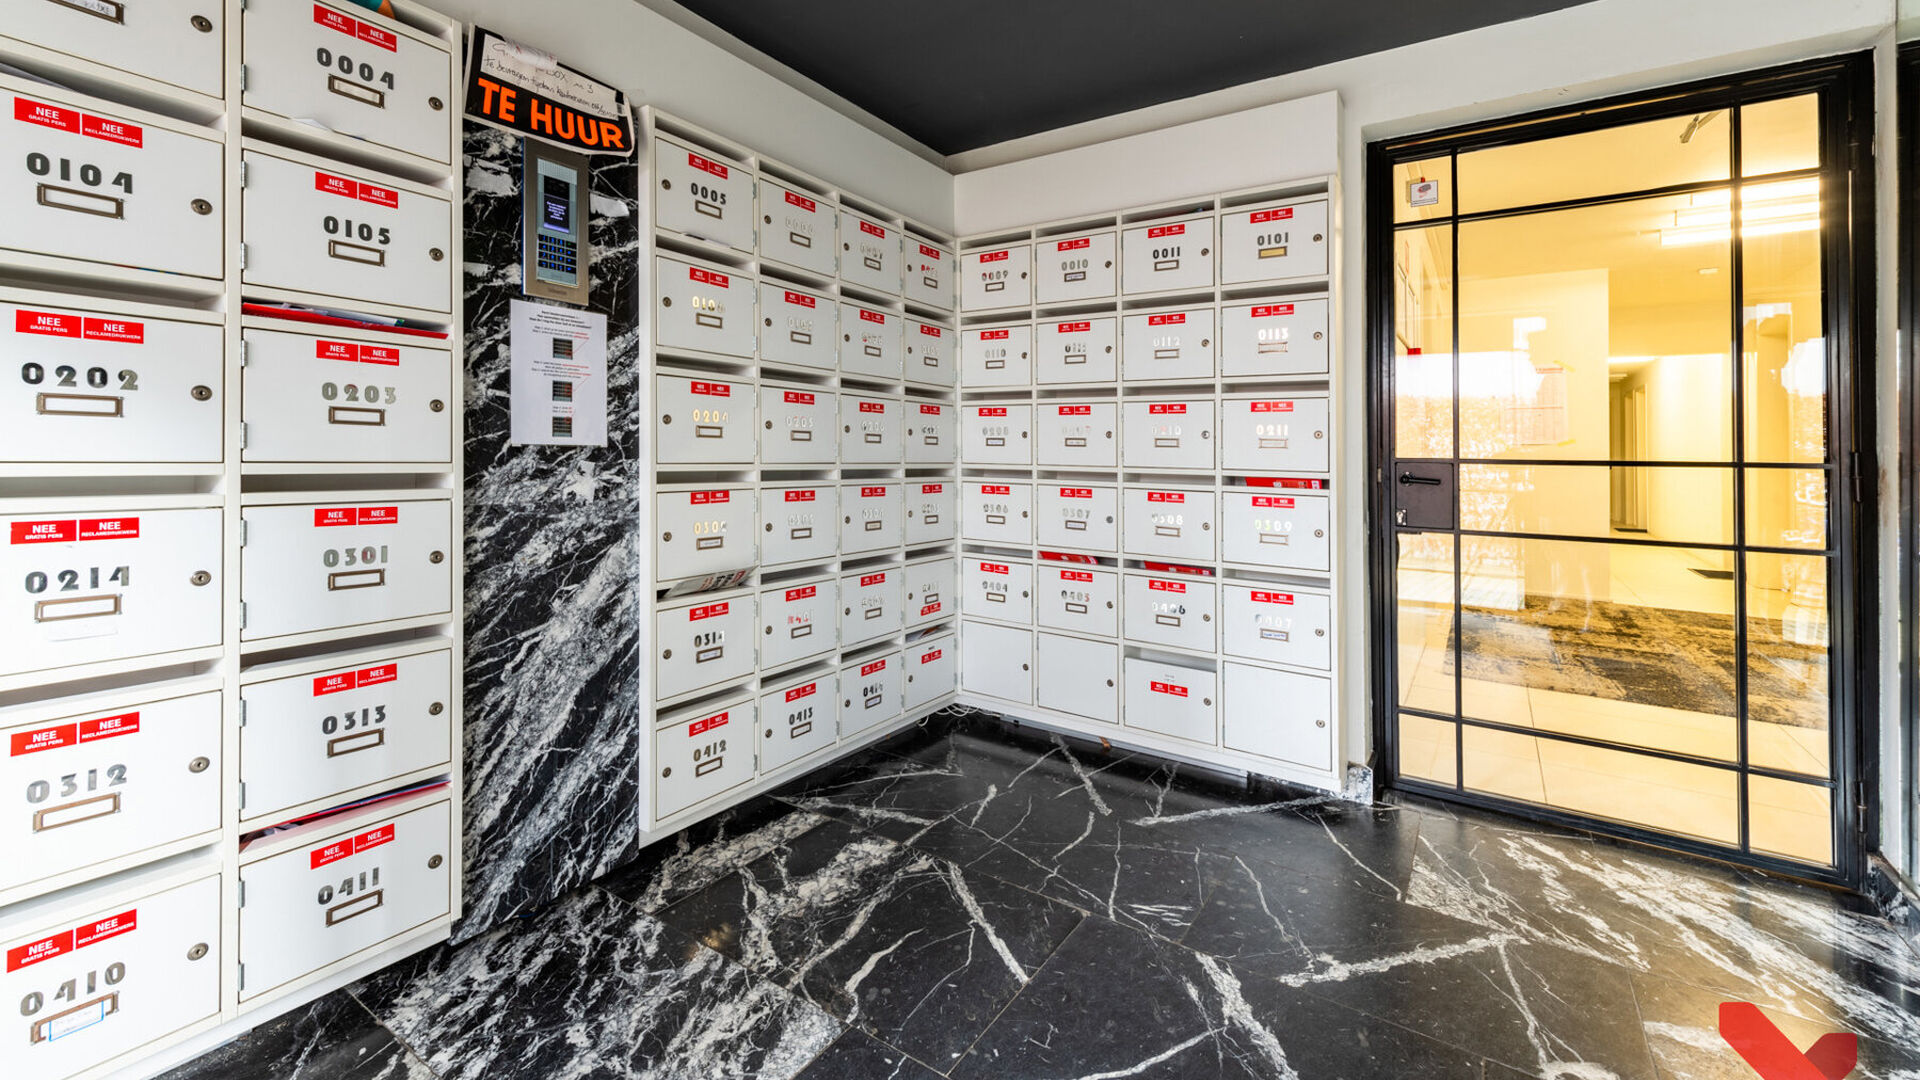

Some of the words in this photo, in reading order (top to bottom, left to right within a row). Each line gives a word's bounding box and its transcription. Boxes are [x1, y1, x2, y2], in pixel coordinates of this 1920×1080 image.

[328, 12, 342, 24] NEE
[370, 29, 384, 40] NEE
[317, 47, 394, 90] 0004
[36, 106, 58, 120] NEE
[478, 78, 517, 123] TE
[531, 98, 625, 149] HUUR
[102, 122, 123, 135] NEE
[27, 152, 133, 194] 0104
[329, 178, 343, 188] NEE
[372, 189, 385, 198] NEE
[690, 182, 726, 205] 0005
[323, 215, 391, 245] 0105
[1257, 232, 1289, 246] 0101
[1153, 246, 1180, 259] 0011
[1061, 259, 1089, 271] 0010
[38, 316, 60, 326] NEE
[104, 323, 124, 333] NEE
[1258, 328, 1289, 340] 0113
[330, 345, 345, 353] NEE
[373, 349, 386, 357] NEE
[21, 362, 138, 390] 0202
[322, 382, 396, 404] 0203
[1256, 424, 1289, 436] 0211
[32, 524, 56, 533] NEE
[99, 522, 120, 530] NEE
[323, 545, 388, 568] 0301
[25, 565, 129, 593] 0214
[370, 669, 384, 677] NEE
[327, 677, 342, 686] NEE
[322, 705, 386, 735] 0313
[789, 706, 813, 725] 0413
[100, 718, 121, 730] NEE
[33, 730, 56, 743] NEE
[692, 739, 727, 762] 0412
[26, 764, 127, 804] 0312
[368, 831, 381, 841] NEE
[324, 845, 339, 857] NEE
[318, 867, 379, 905] 0411
[96, 918, 118, 933] NEE
[29, 940, 52, 956] NEE
[20, 962, 126, 1016] 0410
